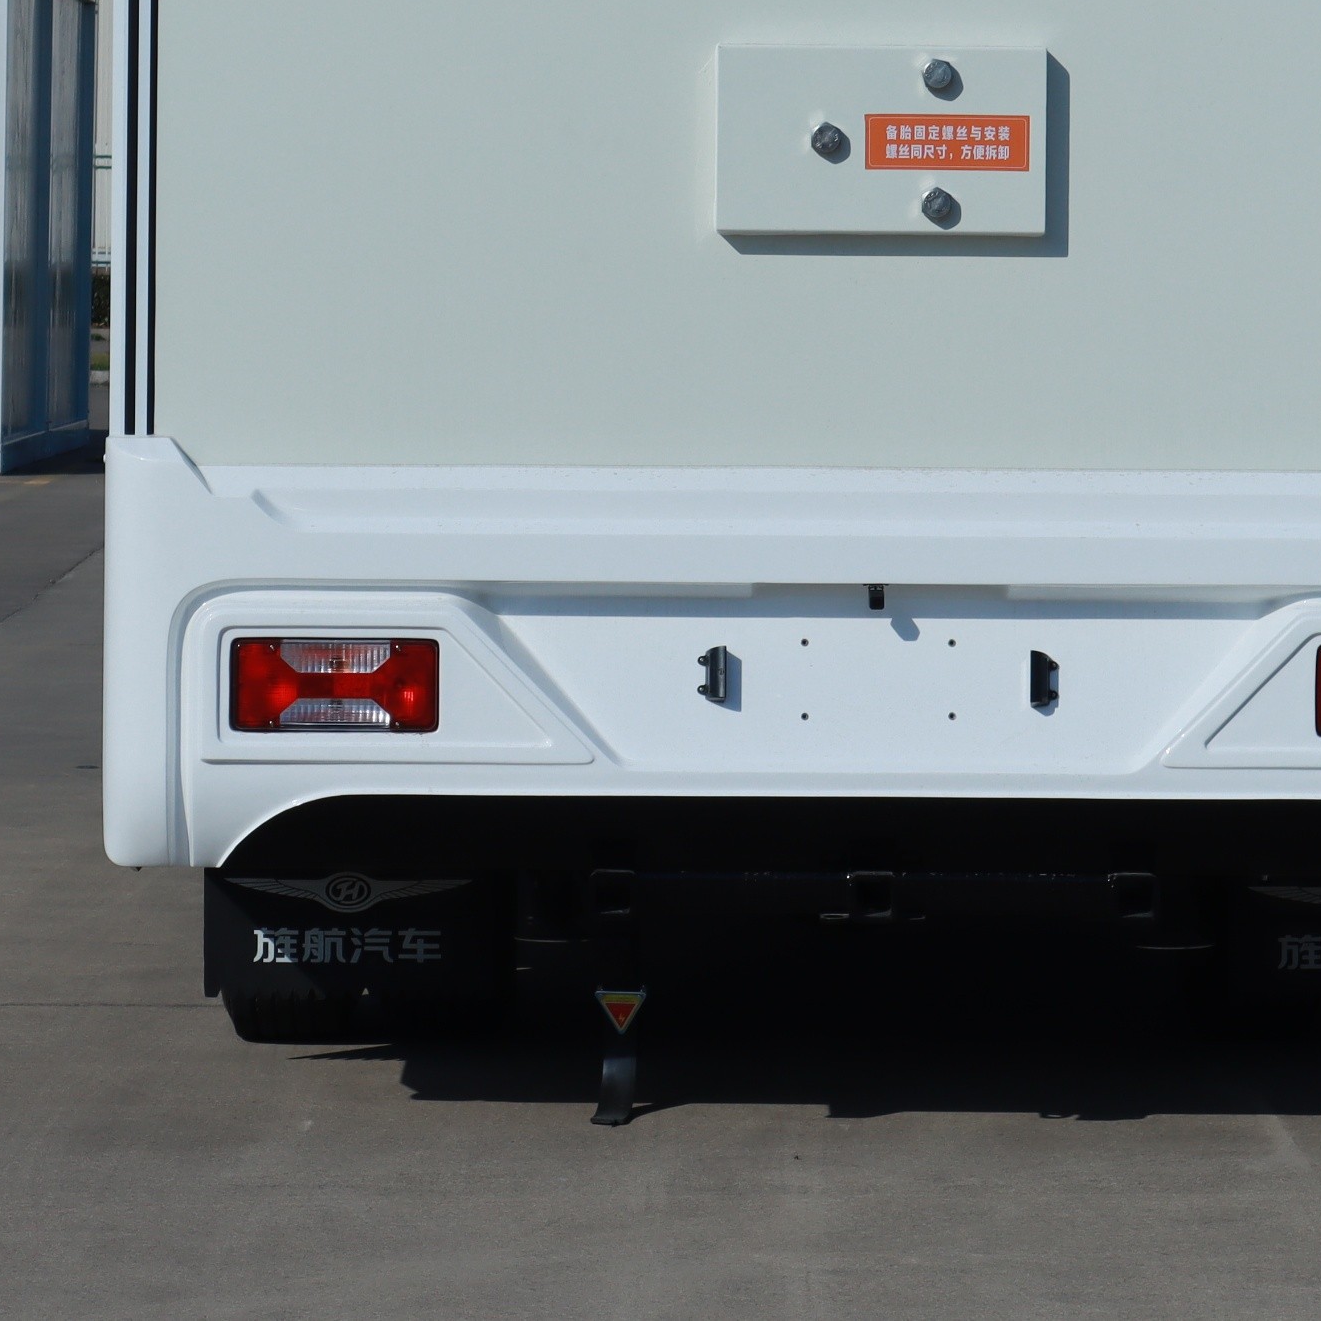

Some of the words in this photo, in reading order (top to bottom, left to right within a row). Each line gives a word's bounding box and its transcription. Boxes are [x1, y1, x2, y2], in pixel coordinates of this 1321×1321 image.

[885, 125, 1010, 141] 备胎固定螺丝与安装
[885, 144, 1010, 160] 螺丝同尺寸，方便拆卸
